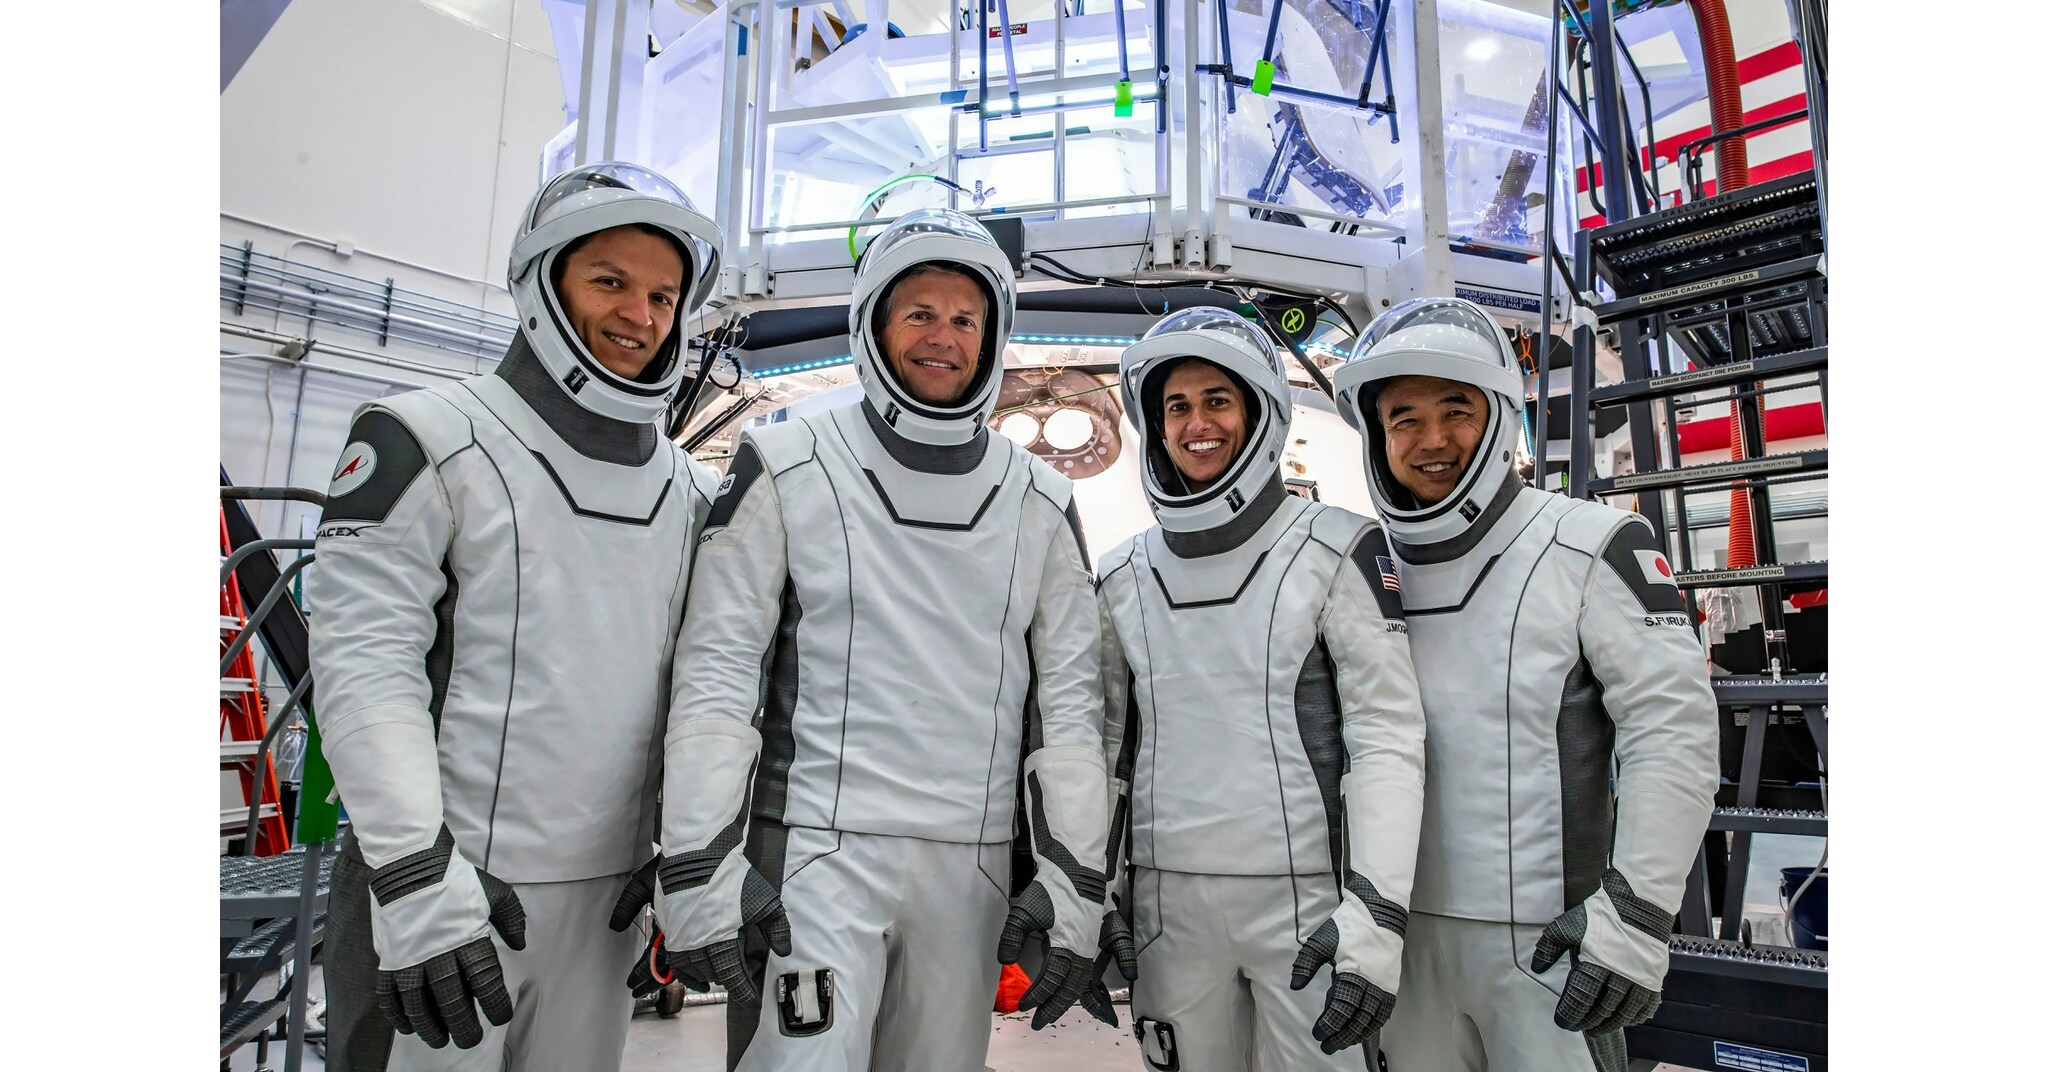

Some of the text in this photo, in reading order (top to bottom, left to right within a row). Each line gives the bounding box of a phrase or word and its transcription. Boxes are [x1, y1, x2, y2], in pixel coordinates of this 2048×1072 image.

[1478, 291, 1518, 303] DISTRIBUTED
[1641, 290, 1678, 302] MAXIMUM
[1680, 280, 1719, 294] CAPACITY
[1651, 377, 1680, 386] MAXIMUM
[1680, 371, 1713, 382] OCCUPANCY
[1727, 364, 1751, 373] PERSON
[1740, 568, 1783, 578] MOUNTING
